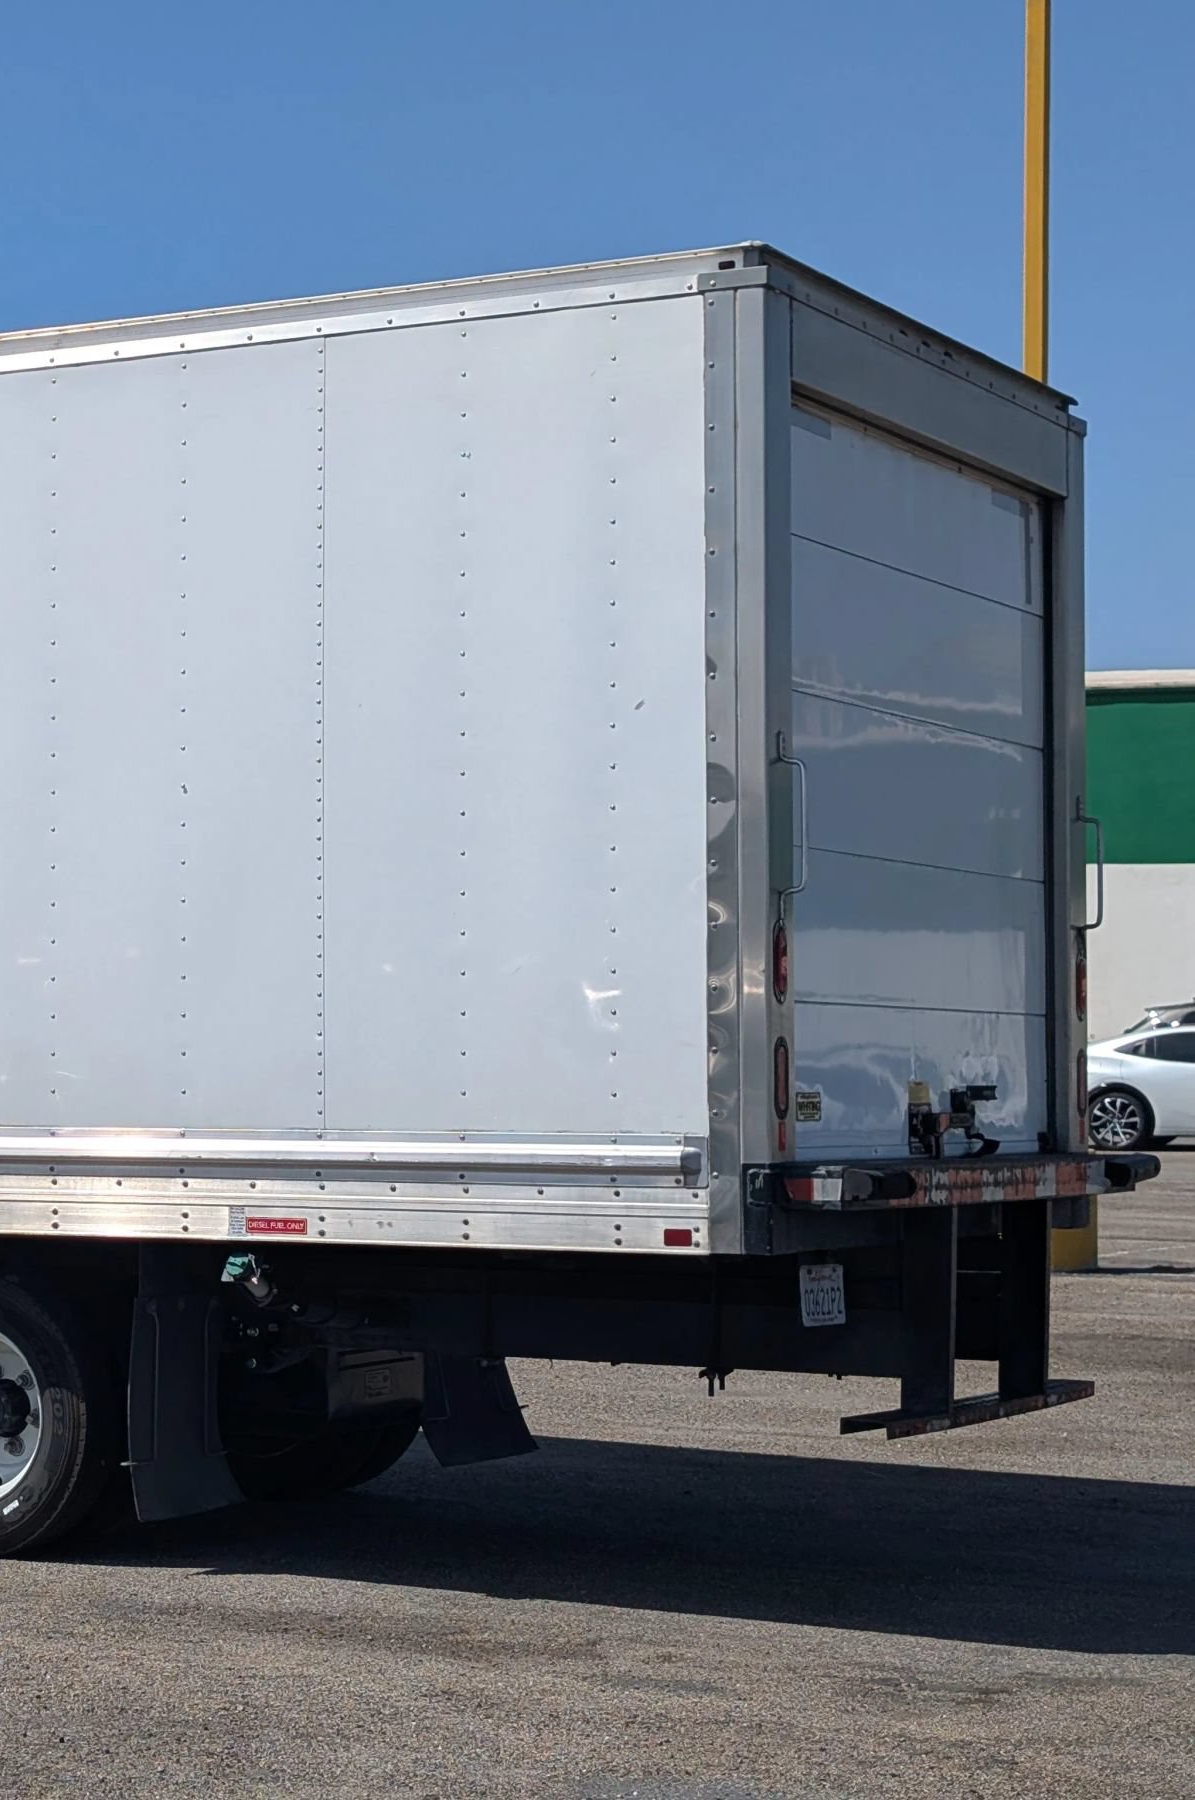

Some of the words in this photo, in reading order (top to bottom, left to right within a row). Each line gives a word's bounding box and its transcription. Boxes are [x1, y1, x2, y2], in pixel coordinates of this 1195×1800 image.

[248, 1221, 270, 1229] DIESEL
[270, 1222, 286, 1230] FUEL
[286, 1222, 305, 1230] ONLY
[804, 1286, 843, 1317] 03621P2
